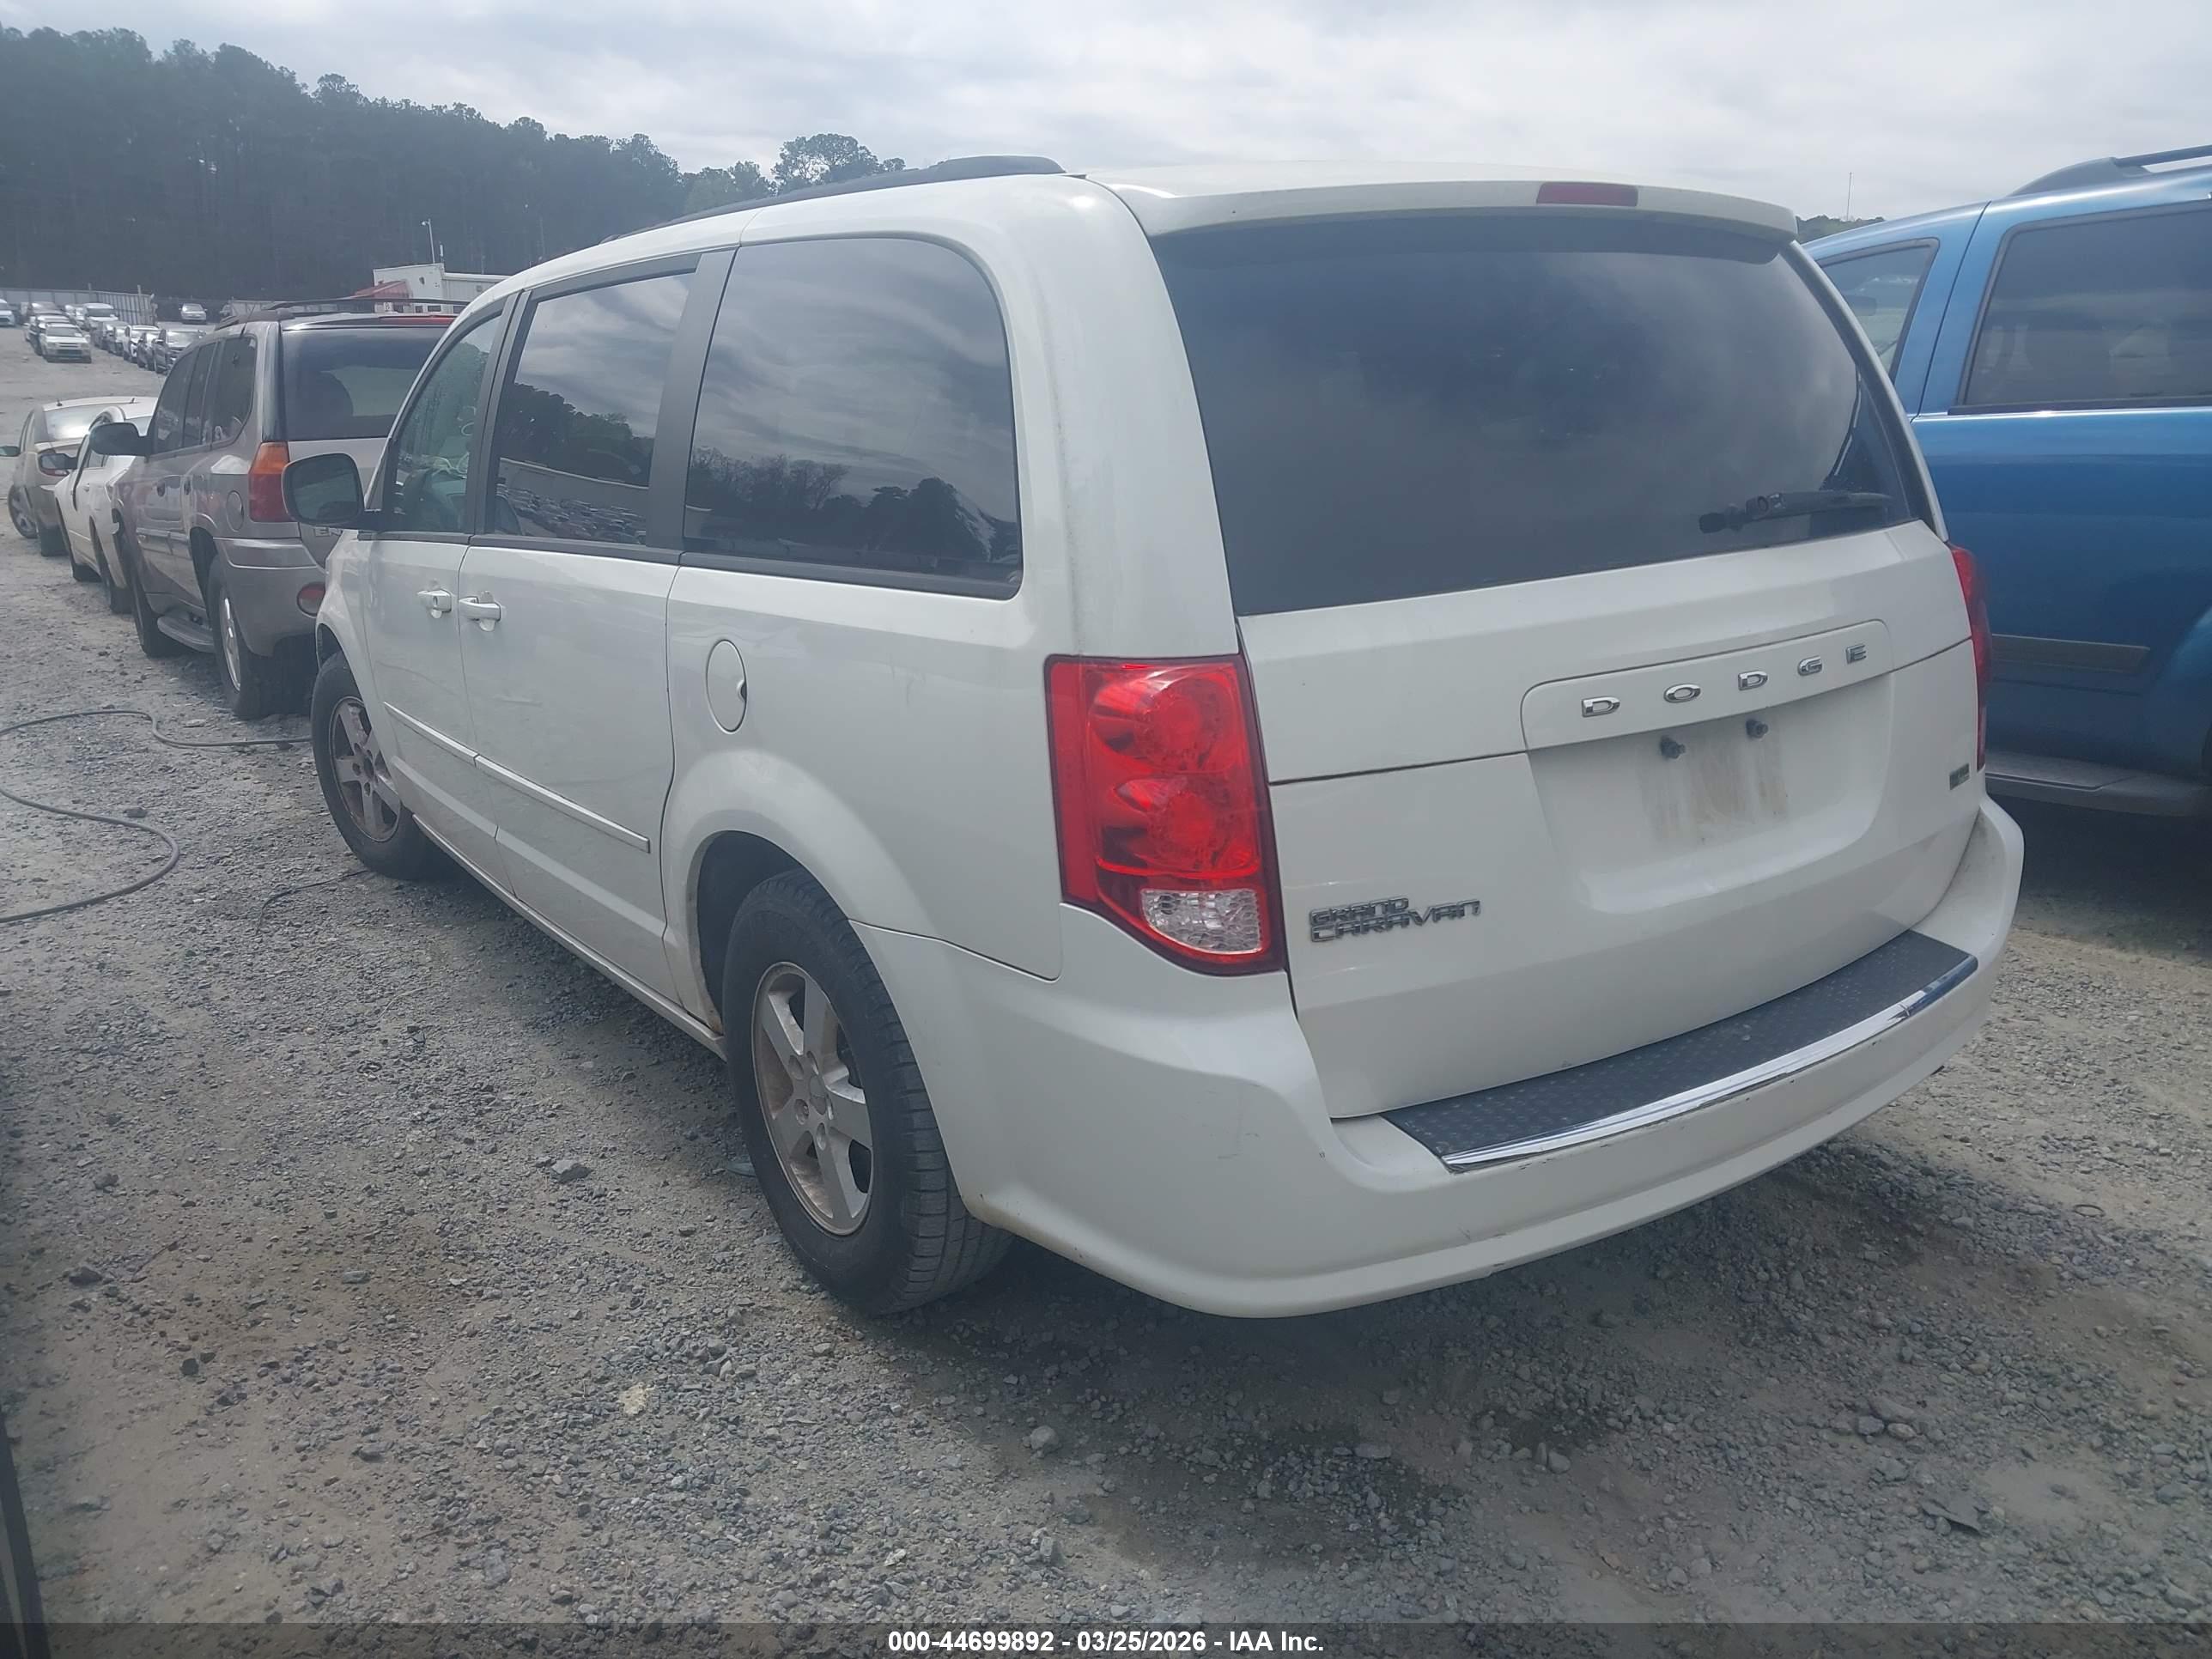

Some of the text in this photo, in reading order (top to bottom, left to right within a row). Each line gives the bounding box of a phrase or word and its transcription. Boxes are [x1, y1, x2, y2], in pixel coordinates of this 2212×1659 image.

[1582, 644, 1867, 718] DODGE
[1310, 896, 1409, 926] GRAND
[1310, 900, 1481, 943] CARAVAN
